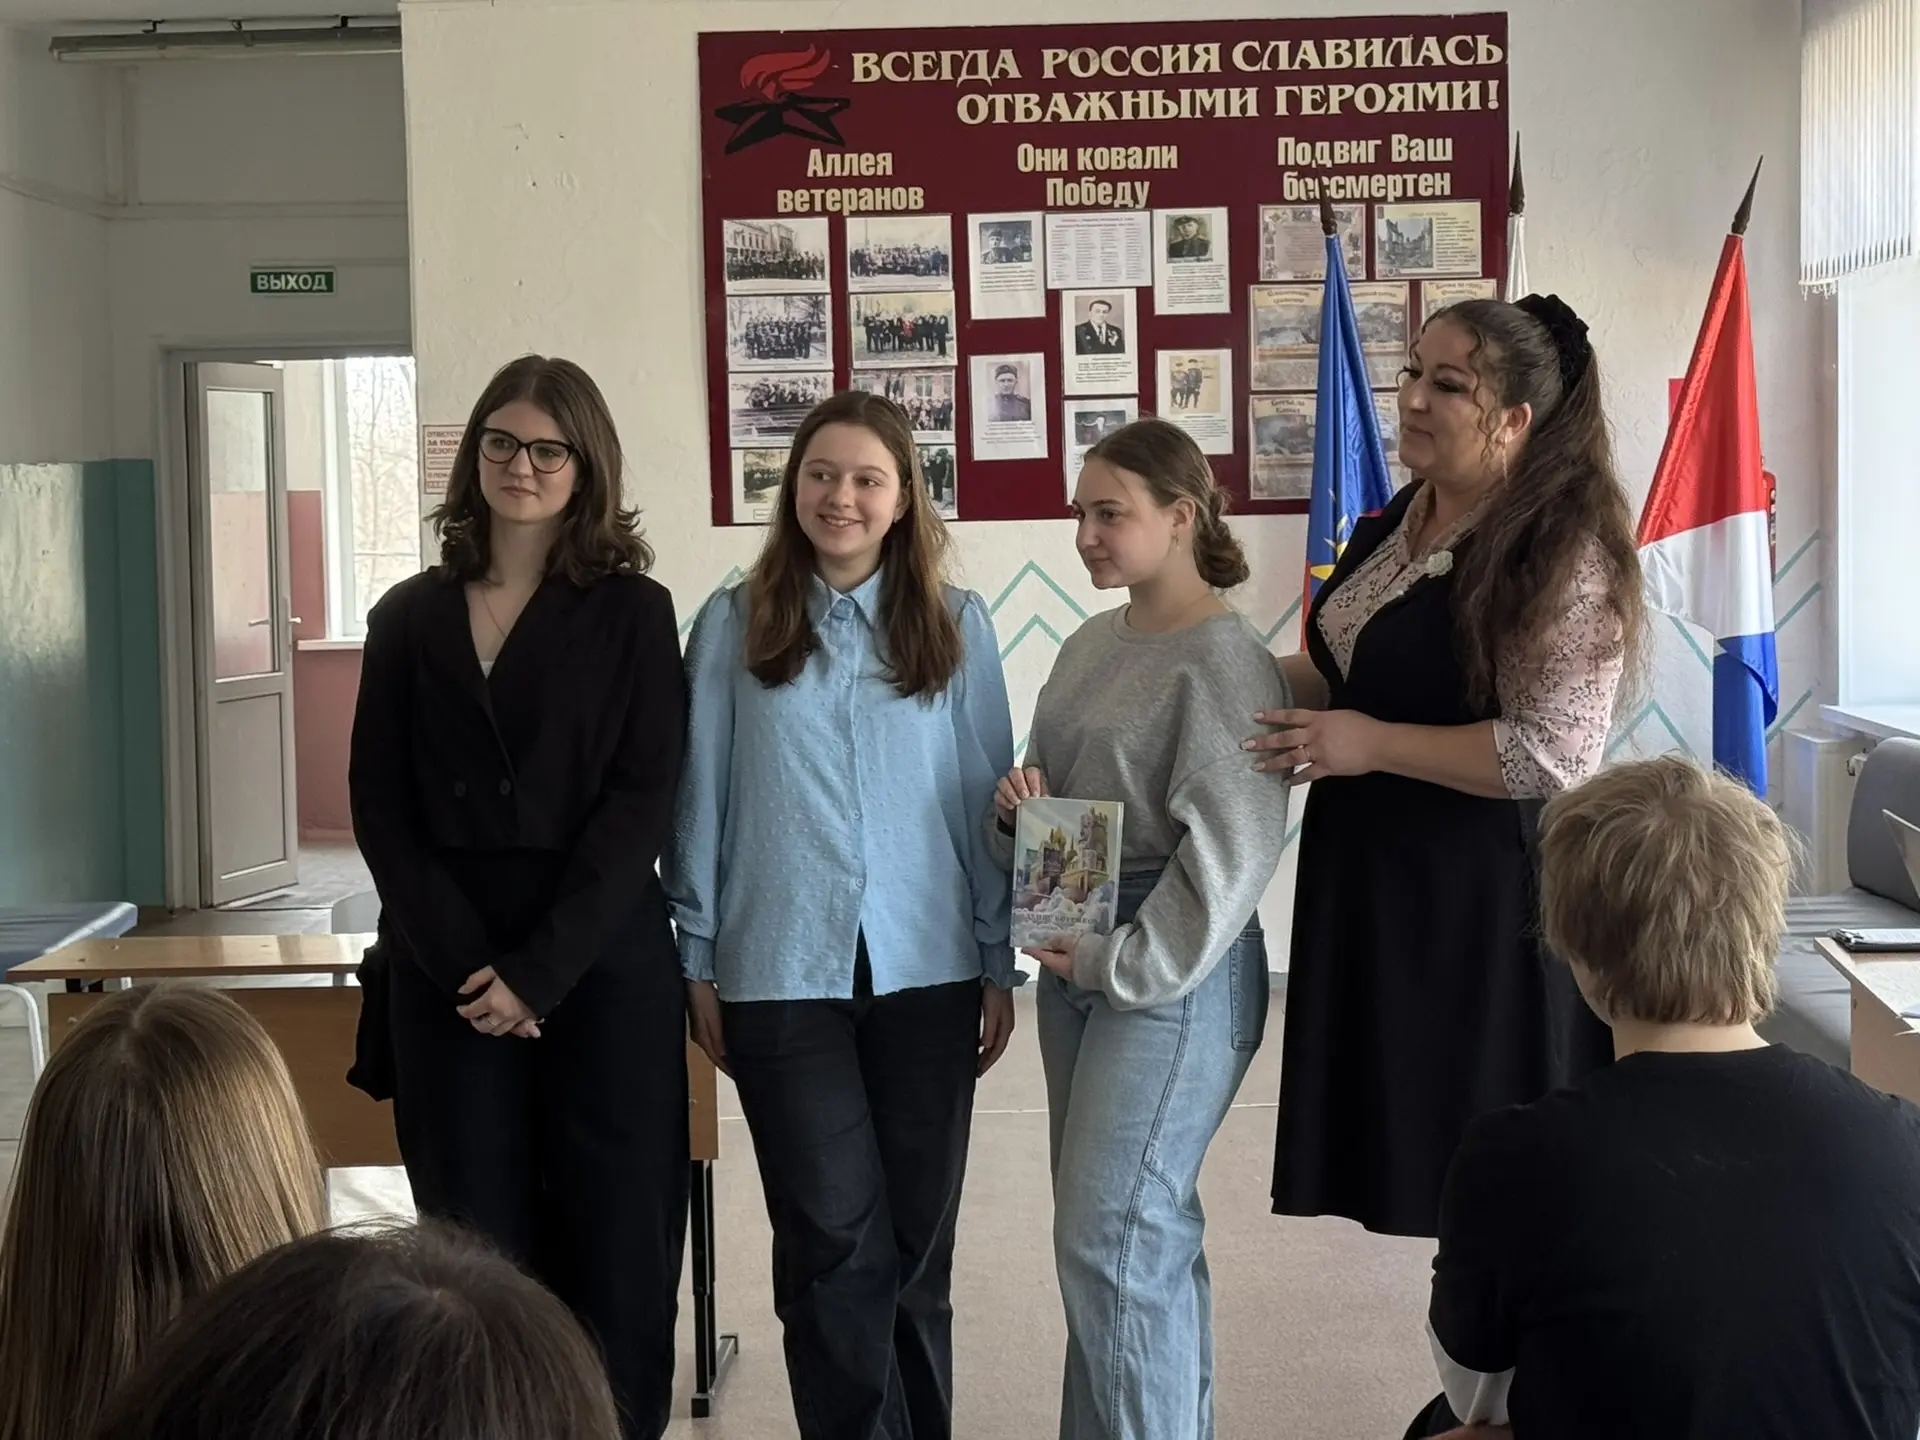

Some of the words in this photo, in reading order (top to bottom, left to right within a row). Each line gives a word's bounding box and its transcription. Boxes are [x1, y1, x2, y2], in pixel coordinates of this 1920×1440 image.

[851, 49, 1022, 87] ВСЕГДА
[1041, 42, 1222, 80] РОССИЯ
[1232, 34, 1503, 72] СЛАВИЛАСЬ
[956, 86, 1260, 125] ОТВАЖНЫМИ
[1274, 79, 1500, 117] ГЕРОЯМИ!
[806, 148, 894, 178] Аллея
[1017, 143, 1069, 173] Они
[1077, 145, 1179, 171] ковали
[1277, 136, 1382, 168] Подвиг
[1391, 133, 1453, 163] Ваш
[776, 186, 925, 216] ветеранов
[1046, 175, 1150, 209] Победу
[256, 274, 328, 291] ВЫХОД
